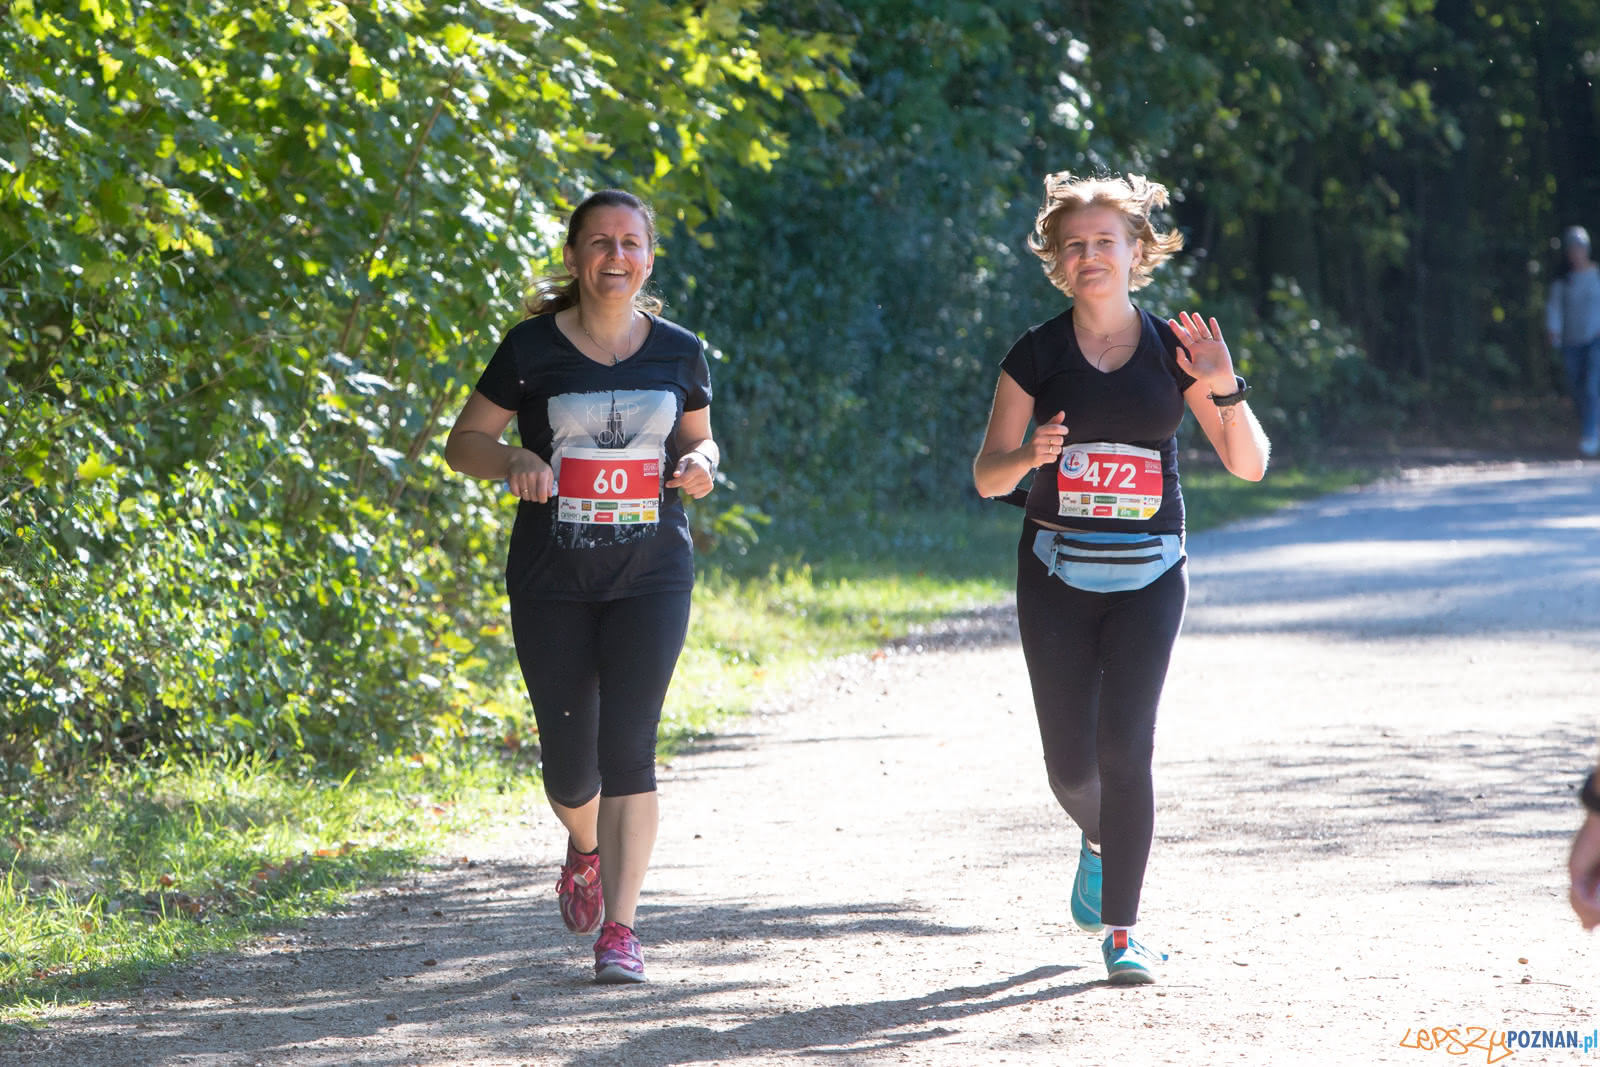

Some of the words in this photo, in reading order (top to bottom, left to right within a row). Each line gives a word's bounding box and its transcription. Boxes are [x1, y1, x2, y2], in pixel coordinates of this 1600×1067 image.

[586, 402, 640, 424] KEEP
[597, 430, 626, 445] ON
[593, 468, 628, 494] 60
[1083, 461, 1137, 489] 472
